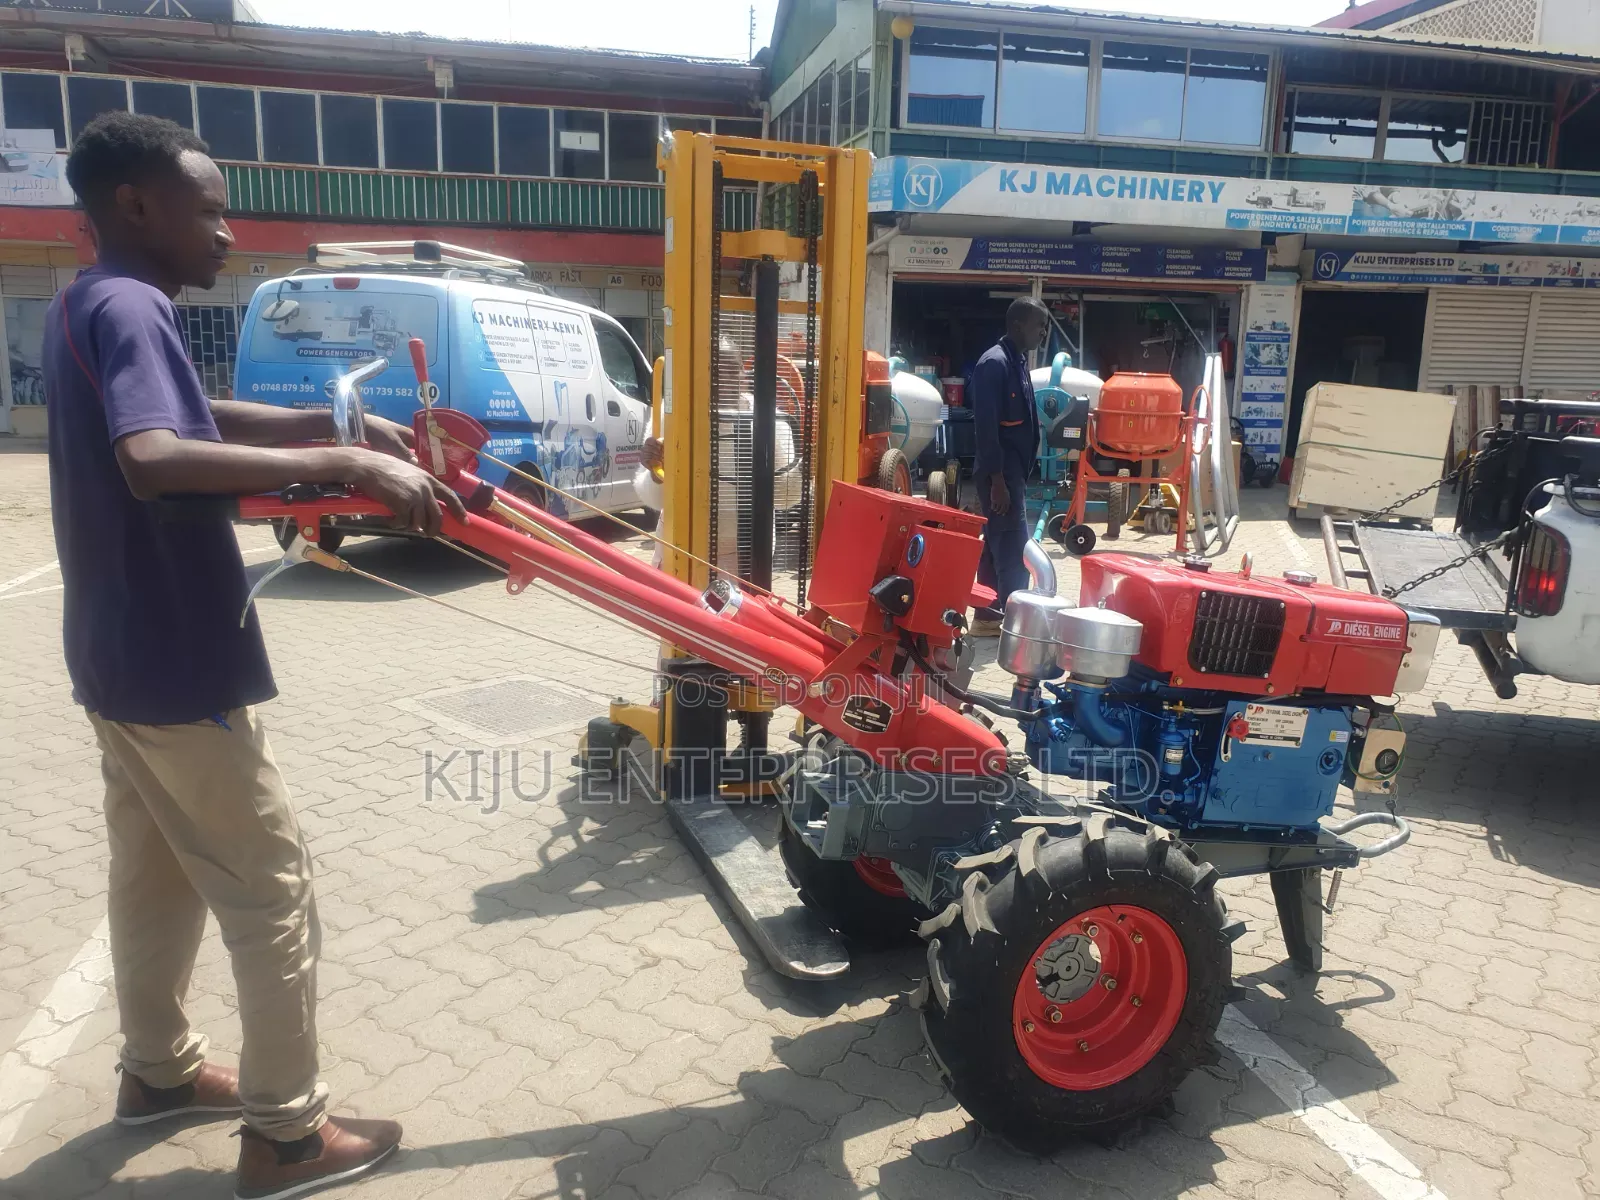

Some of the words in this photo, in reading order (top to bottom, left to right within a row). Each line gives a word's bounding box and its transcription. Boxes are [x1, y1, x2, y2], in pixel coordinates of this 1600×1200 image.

[909, 174, 938, 206] KJ
[999, 168, 1038, 194] KJ
[1045, 171, 1226, 203] MACHINERY
[1230, 212, 1255, 220] POWER
[1256, 213, 1295, 222] GENERATOR
[1296, 215, 1316, 223] SALES
[1323, 217, 1342, 225] LEASE
[1376, 220, 1416, 229] GENERATOR
[1368, 226, 1416, 235] MAINTENANCE
[1353, 255, 1376, 265] KIJU
[1378, 256, 1436, 266] ENTERPRISES
[1436, 258, 1455, 267] LTD
[253, 265, 265, 274] A7
[1320, 258, 1337, 277] KJ
[610, 276, 622, 285] A6
[472, 311, 485, 324] KJ
[488, 313, 549, 331] MACHINERY
[552, 321, 583, 335] KENYA
[260, 383, 280, 392] 0748
[282, 383, 297, 392] 879
[299, 384, 315, 392] 395
[376, 387, 392, 396] 739
[395, 387, 413, 397] 582
[1343, 622, 1371, 637] DIESEL
[1373, 625, 1401, 639] ENGINE
